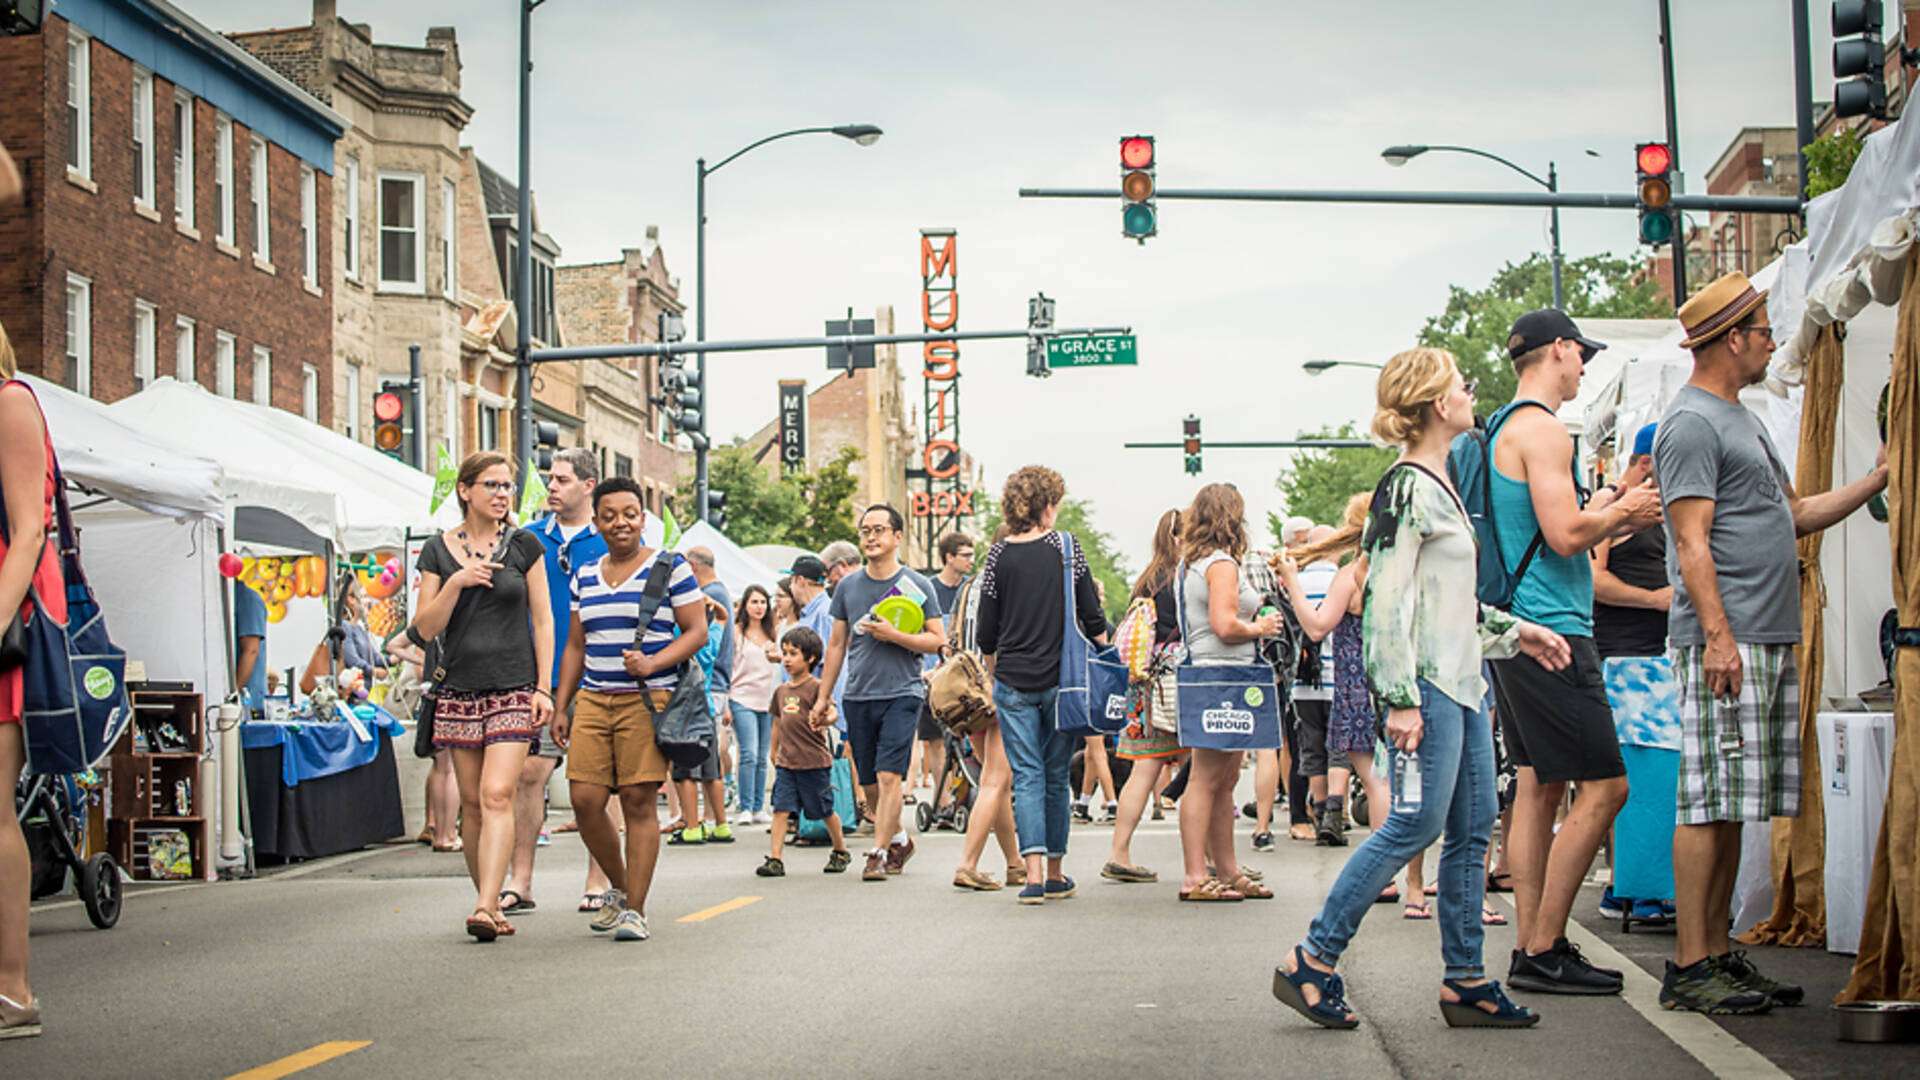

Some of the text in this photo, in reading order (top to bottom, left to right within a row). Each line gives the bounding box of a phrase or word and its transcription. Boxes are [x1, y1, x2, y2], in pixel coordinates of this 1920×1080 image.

[1061, 339, 1117, 354] GRACE
[1120, 340, 1132, 350] ST
[920, 234, 960, 478] MUSIC
[1073, 353, 1113, 364] 3800 N
[913, 491, 975, 515] BOX
[1206, 711, 1252, 720] CHICAGO
[1206, 720, 1252, 731] PROUD
